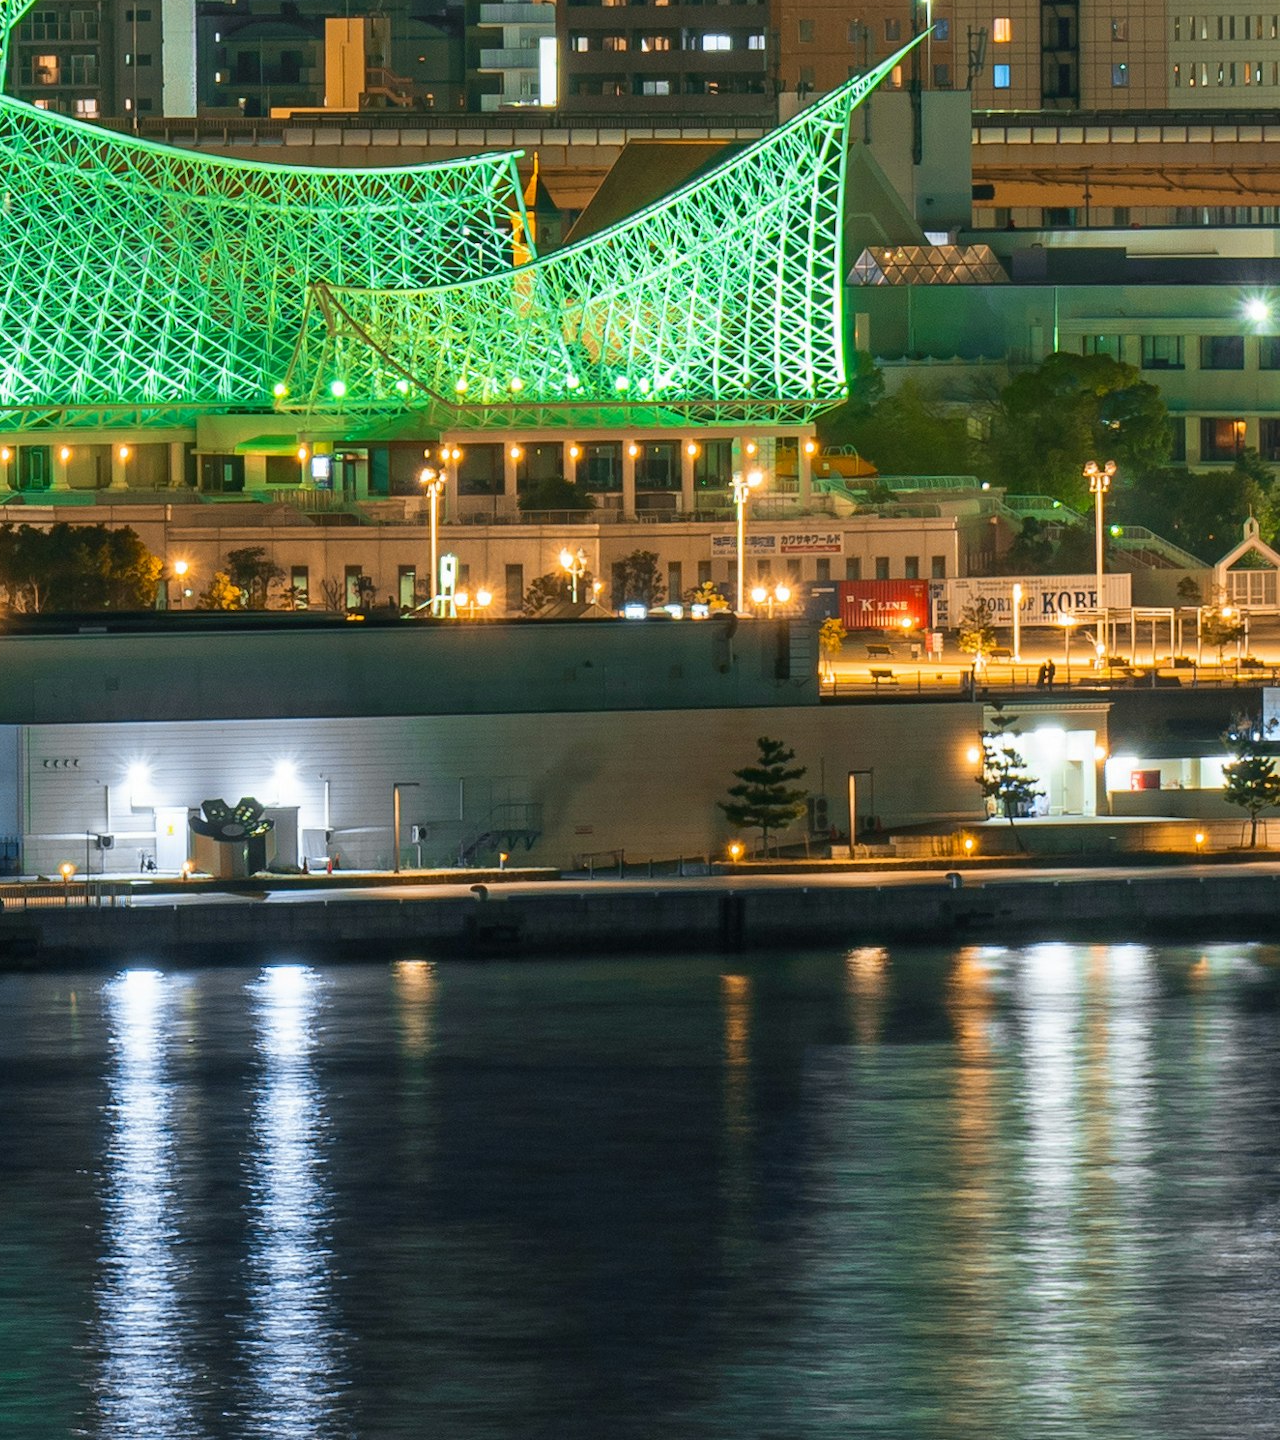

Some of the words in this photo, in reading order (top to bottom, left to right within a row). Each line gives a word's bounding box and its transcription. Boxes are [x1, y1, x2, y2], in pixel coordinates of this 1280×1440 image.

[781, 534, 841, 545] カワサキワールド
[877, 600, 908, 611] LINE
